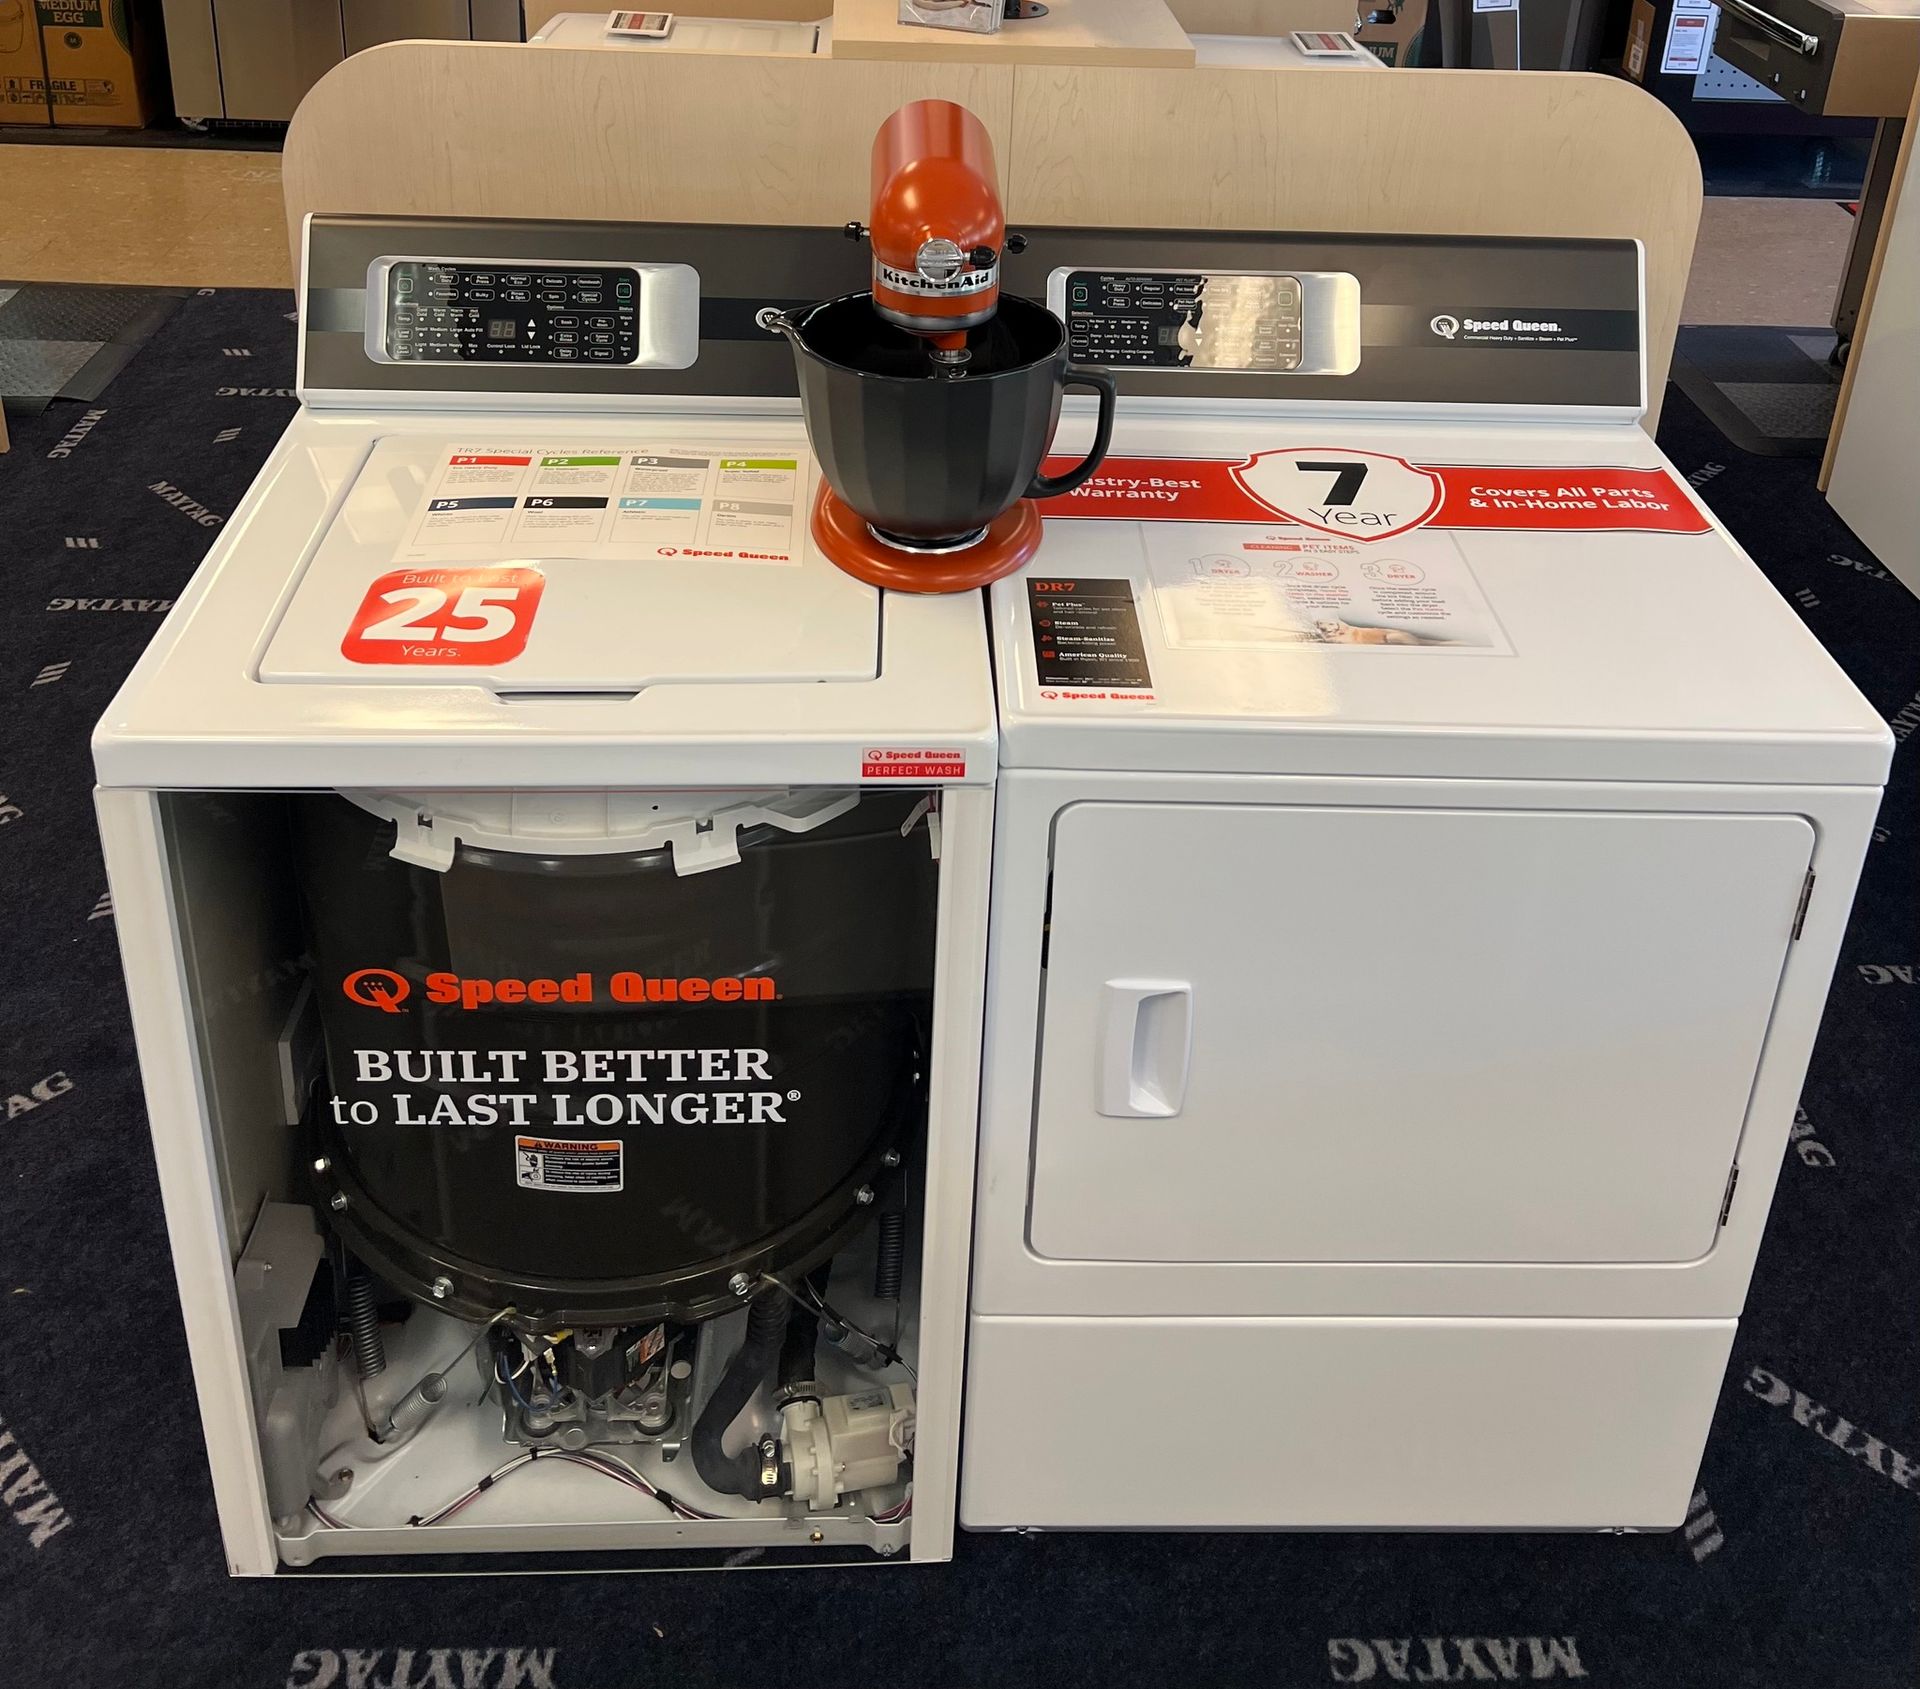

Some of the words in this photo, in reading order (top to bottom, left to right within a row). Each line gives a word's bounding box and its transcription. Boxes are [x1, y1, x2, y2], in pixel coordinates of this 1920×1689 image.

[40, 0, 98, 11] MEDIUM
[54, 11, 84, 23] EGG
[29, 80, 77, 91] FRGILE
[883, 269, 989, 289] KitchenAid
[1463, 318, 1509, 332] Speed
[215, 386, 297, 398] AYTAG
[47, 409, 109, 460] MAYTAG
[1295, 461, 1368, 506] 7
[1068, 488, 1180, 502] Warranty
[1470, 486, 1550, 498] Covers
[1556, 486, 1586, 497] All
[1591, 487, 1655, 498] Parts
[148, 480, 224, 527] MAYTAG
[436, 500, 458, 509] P5
[531, 499, 554, 507] P6
[719, 503, 740, 511] P8
[1469, 498, 1489, 508] &
[1495, 499, 1598, 509] In-Home
[1604, 500, 1670, 512] Labor
[1308, 508, 1398, 526] Year
[682, 549, 733, 558] Speed
[738, 551, 789, 561] Queen
[402, 574, 446, 584] Built
[1035, 582, 1076, 592] DR7
[359, 586, 520, 643] 25
[401, 644, 461, 657] Years.
[886, 751, 921, 760] Speed
[867, 766, 920, 775] PERFECT
[925, 766, 961, 775] WASH
[425, 972, 593, 1010] Speed
[352, 1050, 527, 1082] BUILT
[542, 1048, 774, 1082] BETTER
[330, 1095, 379, 1126] to
[394, 1094, 537, 1126] LAST
[544, 1141, 598, 1150] WARNING
[1327, 1636, 1588, 1682] MAYTAG
[286, 1647, 558, 1689] MAYTAG
